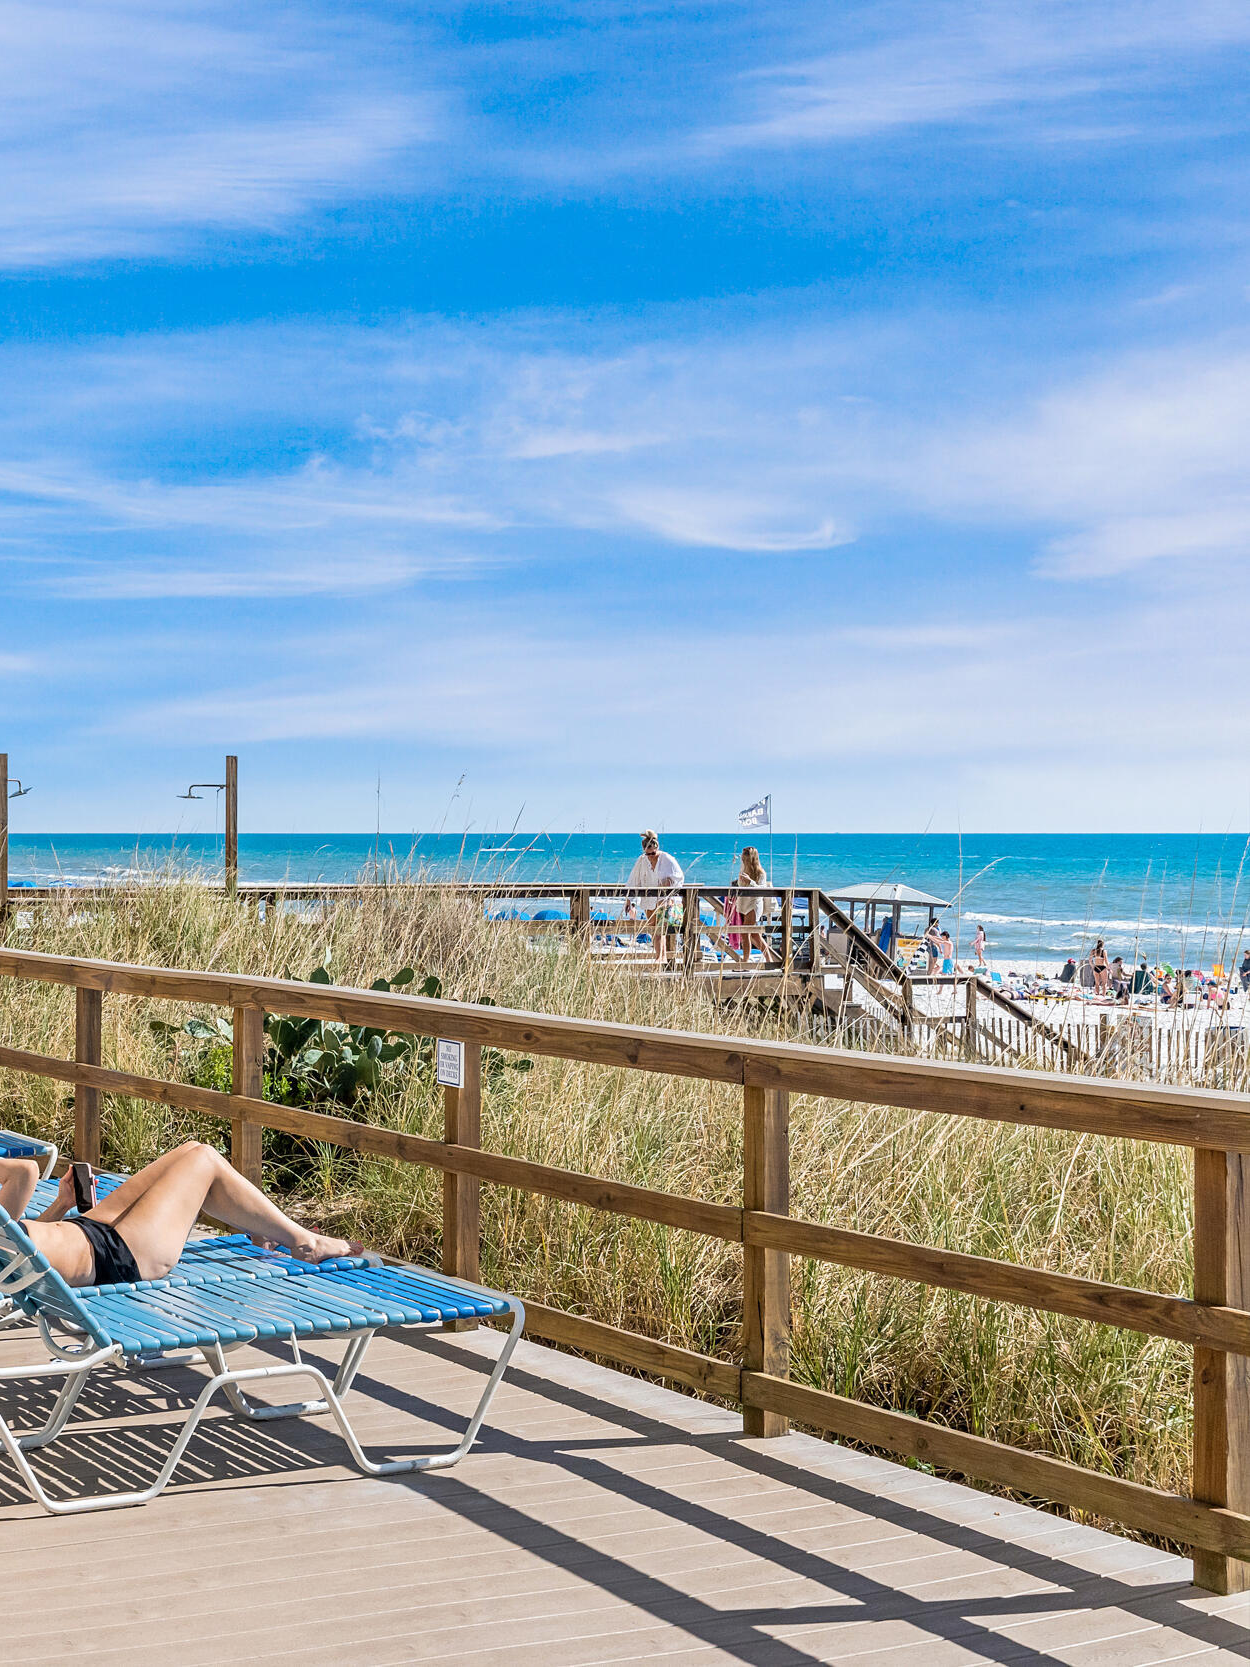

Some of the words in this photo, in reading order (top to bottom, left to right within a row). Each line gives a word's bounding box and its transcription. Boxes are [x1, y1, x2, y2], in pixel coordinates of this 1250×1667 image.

[440, 1053, 457, 1062] SMOKING
[445, 1062, 458, 1070] VAPING
[440, 1069, 445, 1077] ON
[445, 1070, 457, 1079] DECKS
